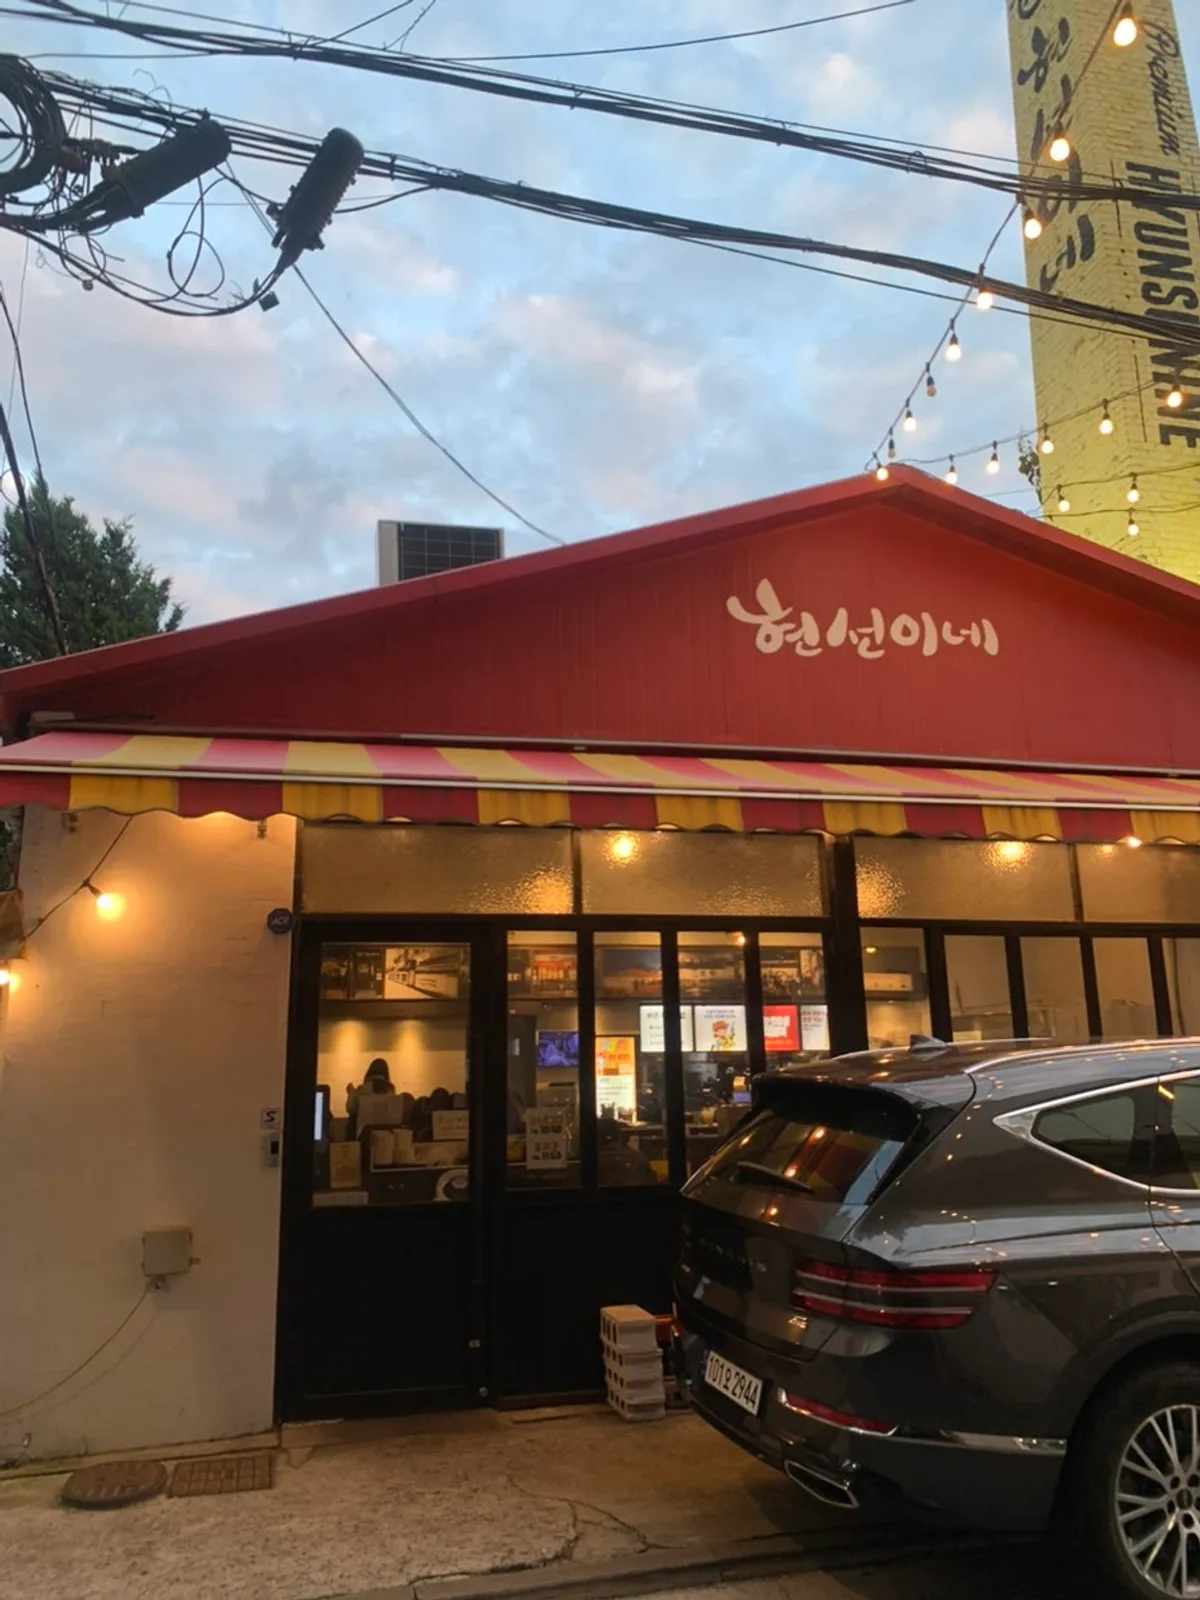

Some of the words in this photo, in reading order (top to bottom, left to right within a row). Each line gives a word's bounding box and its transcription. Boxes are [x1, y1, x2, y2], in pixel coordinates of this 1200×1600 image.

[1139, 20, 1181, 156] Premium
[726, 578, 999, 659] 현선이네
[707, 1355, 732, 1391] 101오
[731, 1371, 759, 1410] 2944
